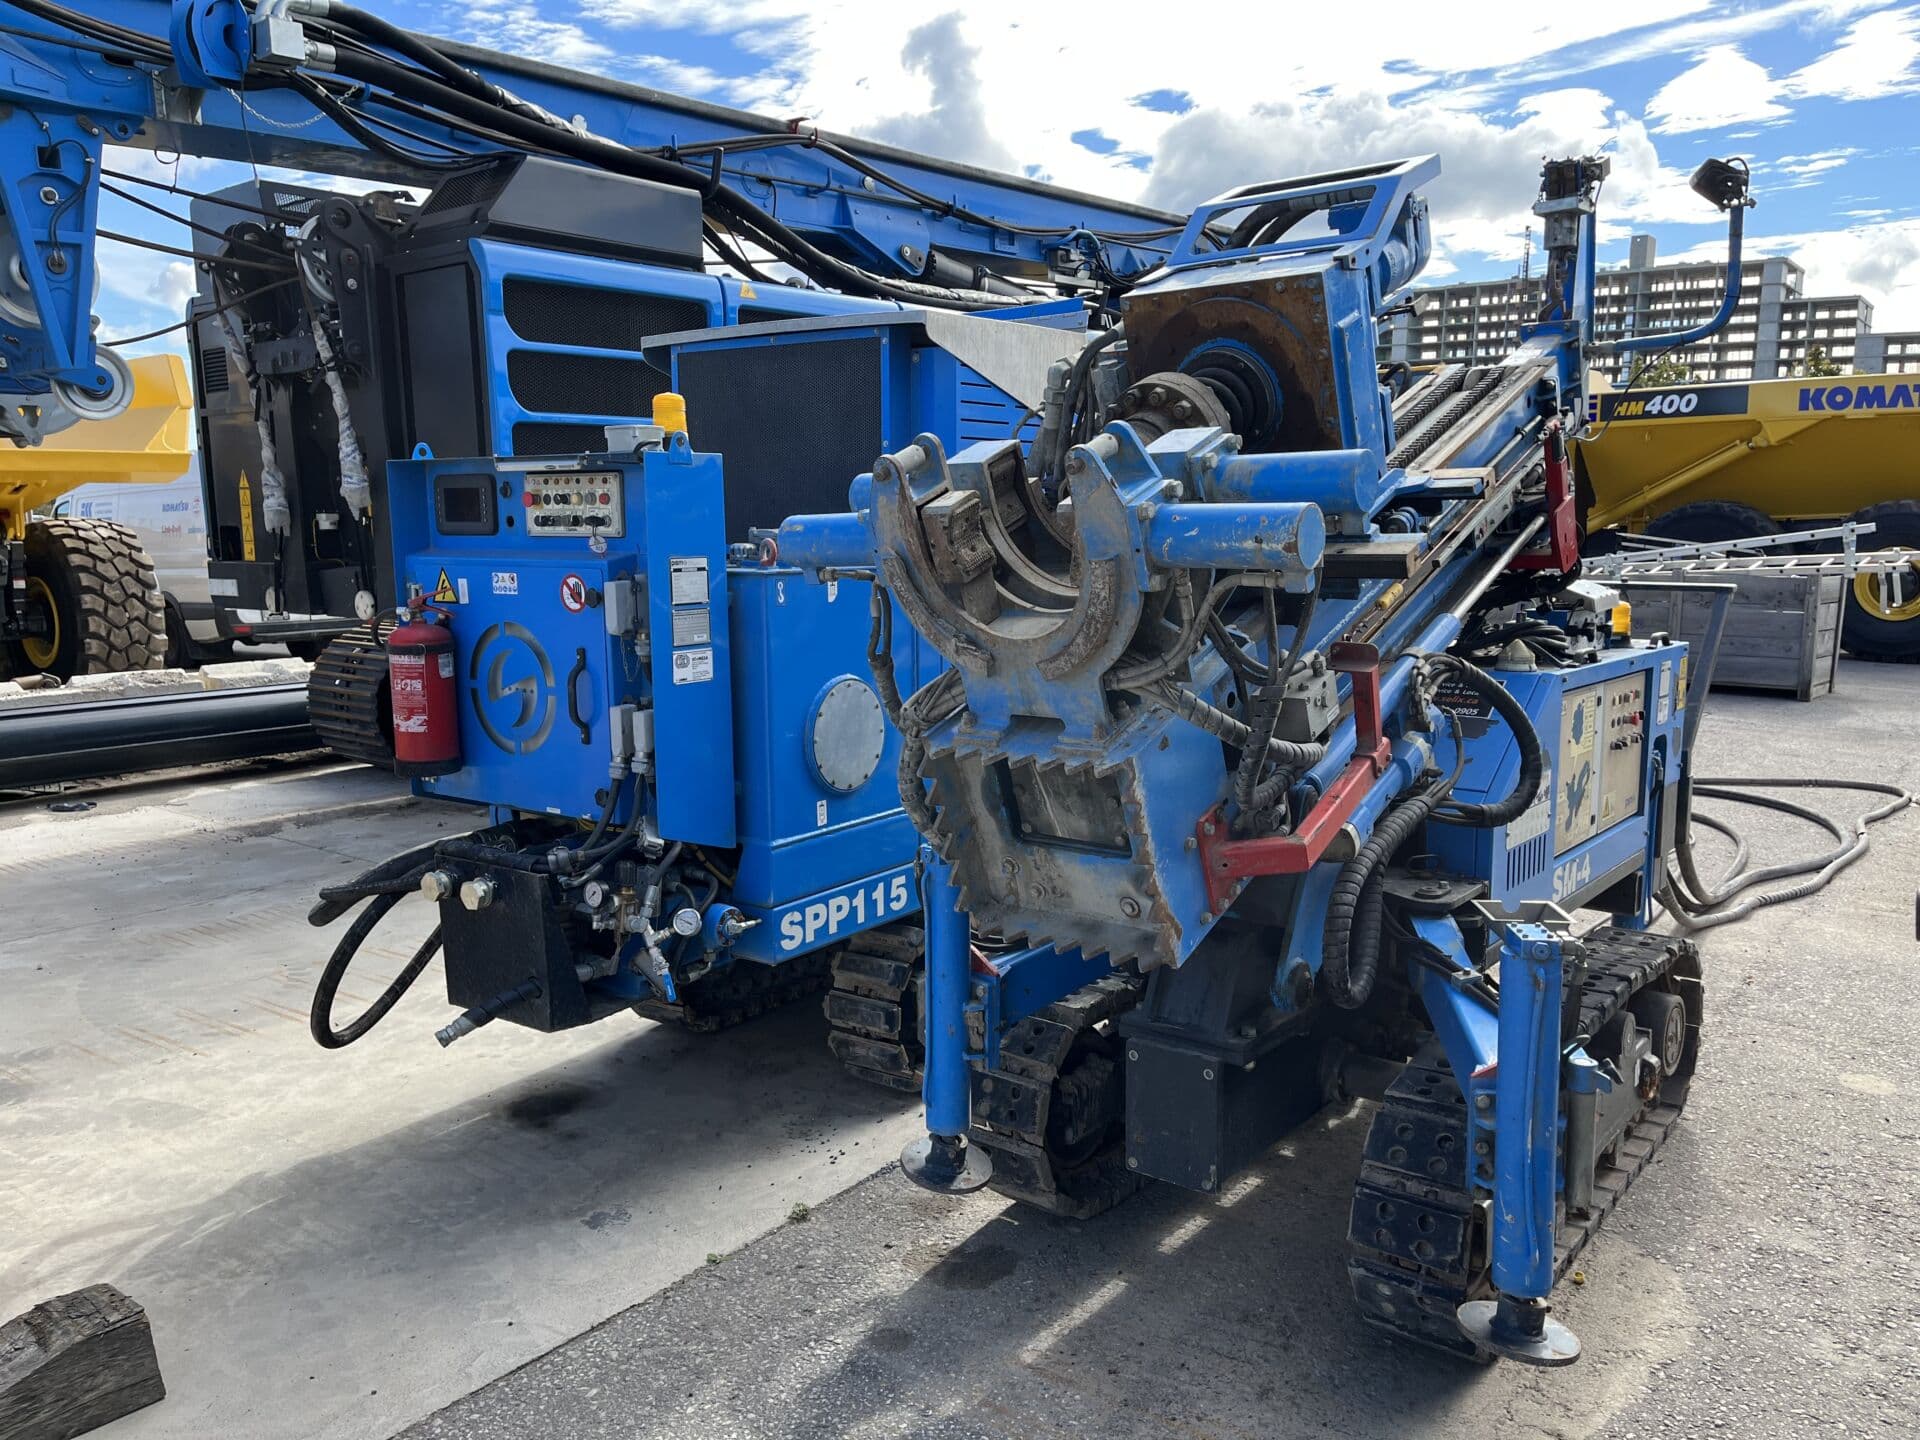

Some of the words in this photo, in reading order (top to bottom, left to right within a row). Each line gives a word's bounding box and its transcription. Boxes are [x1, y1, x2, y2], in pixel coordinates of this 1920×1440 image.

[1614, 393, 1698, 416] HM400
[1552, 853, 1592, 904] SM-4
[780, 875, 908, 951] SPP115
